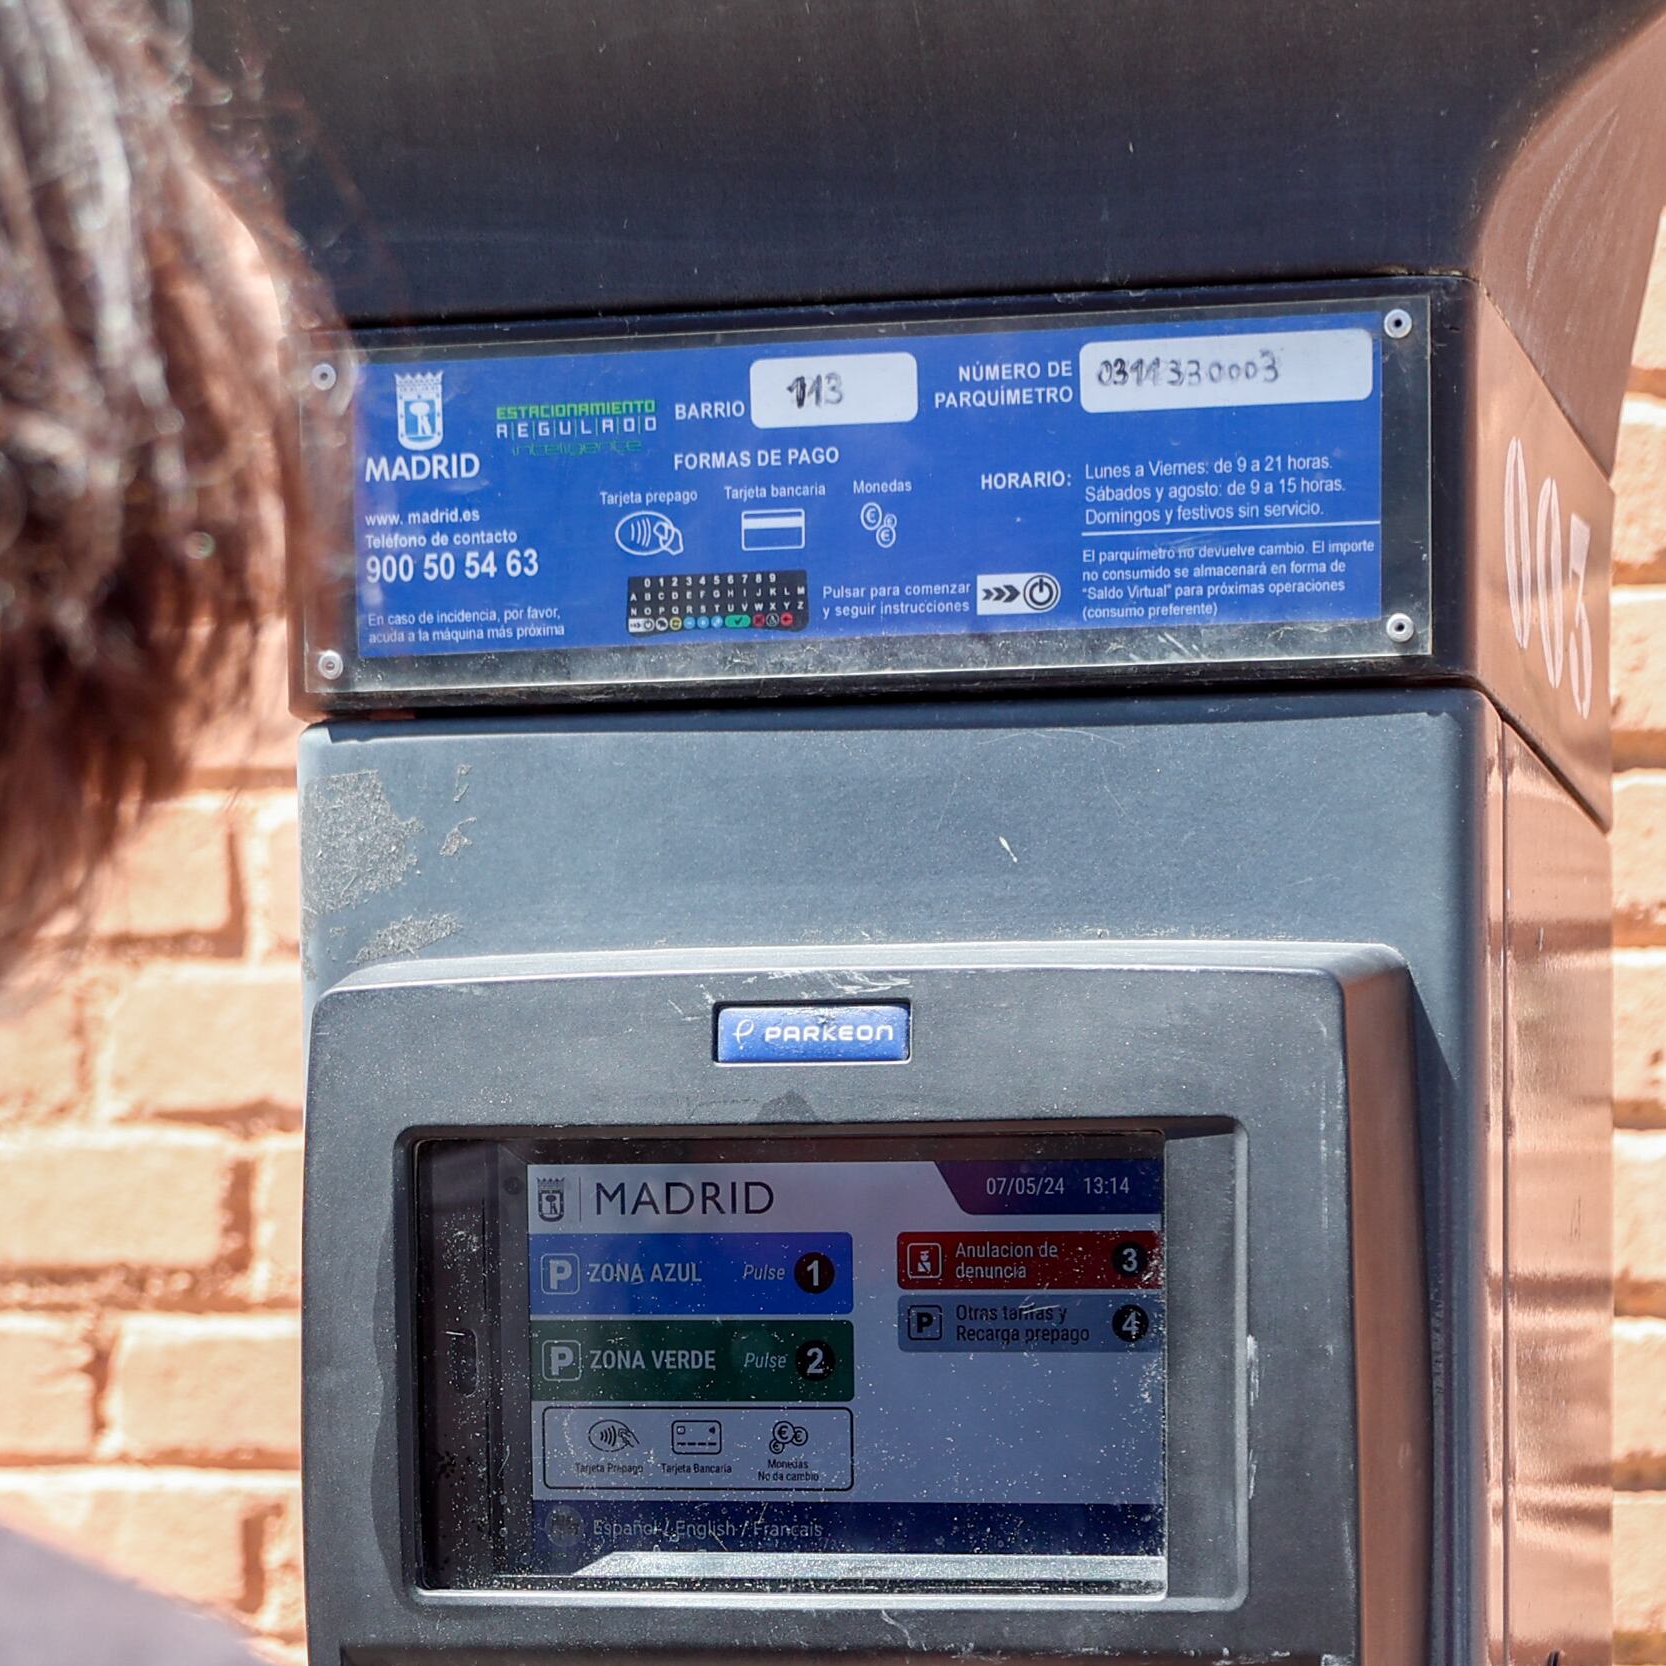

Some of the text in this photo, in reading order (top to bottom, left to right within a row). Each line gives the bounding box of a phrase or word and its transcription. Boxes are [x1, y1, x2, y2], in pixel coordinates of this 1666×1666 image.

[958, 360, 1072, 382] NÚMERO DE
[934, 385, 1073, 409] PARQUÍMETRO
[496, 399, 656, 420] ESTACIONAMIENTO
[675, 400, 745, 420] BARRIO
[365, 453, 480, 482] MADRID
[674, 446, 839, 470] FORMAS DE PAGO
[1085, 454, 1332, 480] Lunes a Viernes: de 9 a 21 horas.
[853, 478, 912, 494] Monedas
[981, 470, 1071, 490] HORARIO:
[1085, 476, 1345, 503] Sábados y agosto: de 9 a 15 horas.
[599, 490, 698, 508] Tarjeta prepago
[724, 483, 826, 502] Tarjeta bancaria
[365, 507, 480, 526] www. madrid.es
[1085, 500, 1324, 527] Domingos y festivos sin servicio.
[365, 529, 518, 549] Teléfono de contacto
[1082, 549, 1095, 563] El
[1098, 546, 1175, 565] parquímetro
[1177, 546, 1195, 559] no
[1198, 543, 1256, 558] devuelve
[1312, 540, 1325, 554] El
[1328, 539, 1375, 556] importe
[365, 548, 539, 584] 900 50 54 63
[1082, 559, 1346, 582] no consumido se almacenará en forma de
[823, 582, 972, 601] Pulsar para comenzar
[1174, 585, 1204, 600] para
[1207, 581, 1265, 599] próximas
[1268, 579, 1346, 596] operaciones
[367, 606, 561, 627] En caso de incidencia, por favor,
[822, 599, 970, 620] y seguir instrucciones
[1082, 602, 1218, 622] (consumo preferente)
[369, 623, 565, 644] acuda a la máquina más próxima
[764, 1023, 895, 1043] PARKEON
[986, 1176, 1130, 1196] 07/05/24 13:14
[596, 1181, 774, 1216] MADRID
[955, 1240, 1060, 1260] Anulacion de
[1122, 1247, 1139, 1274] 3
[588, 1260, 703, 1286] ZONA AZUL
[742, 1260, 786, 1281] Pulse
[806, 1259, 819, 1286] 1
[955, 1261, 1026, 1283] denuncia
[1121, 1308, 1144, 1340] 4
[956, 1324, 1090, 1346] Recarga prepago
[589, 1349, 716, 1375] ZONA VERDE
[743, 1351, 789, 1372] Pulse
[806, 1347, 826, 1374] 2
[676, 1520, 735, 1539] English
